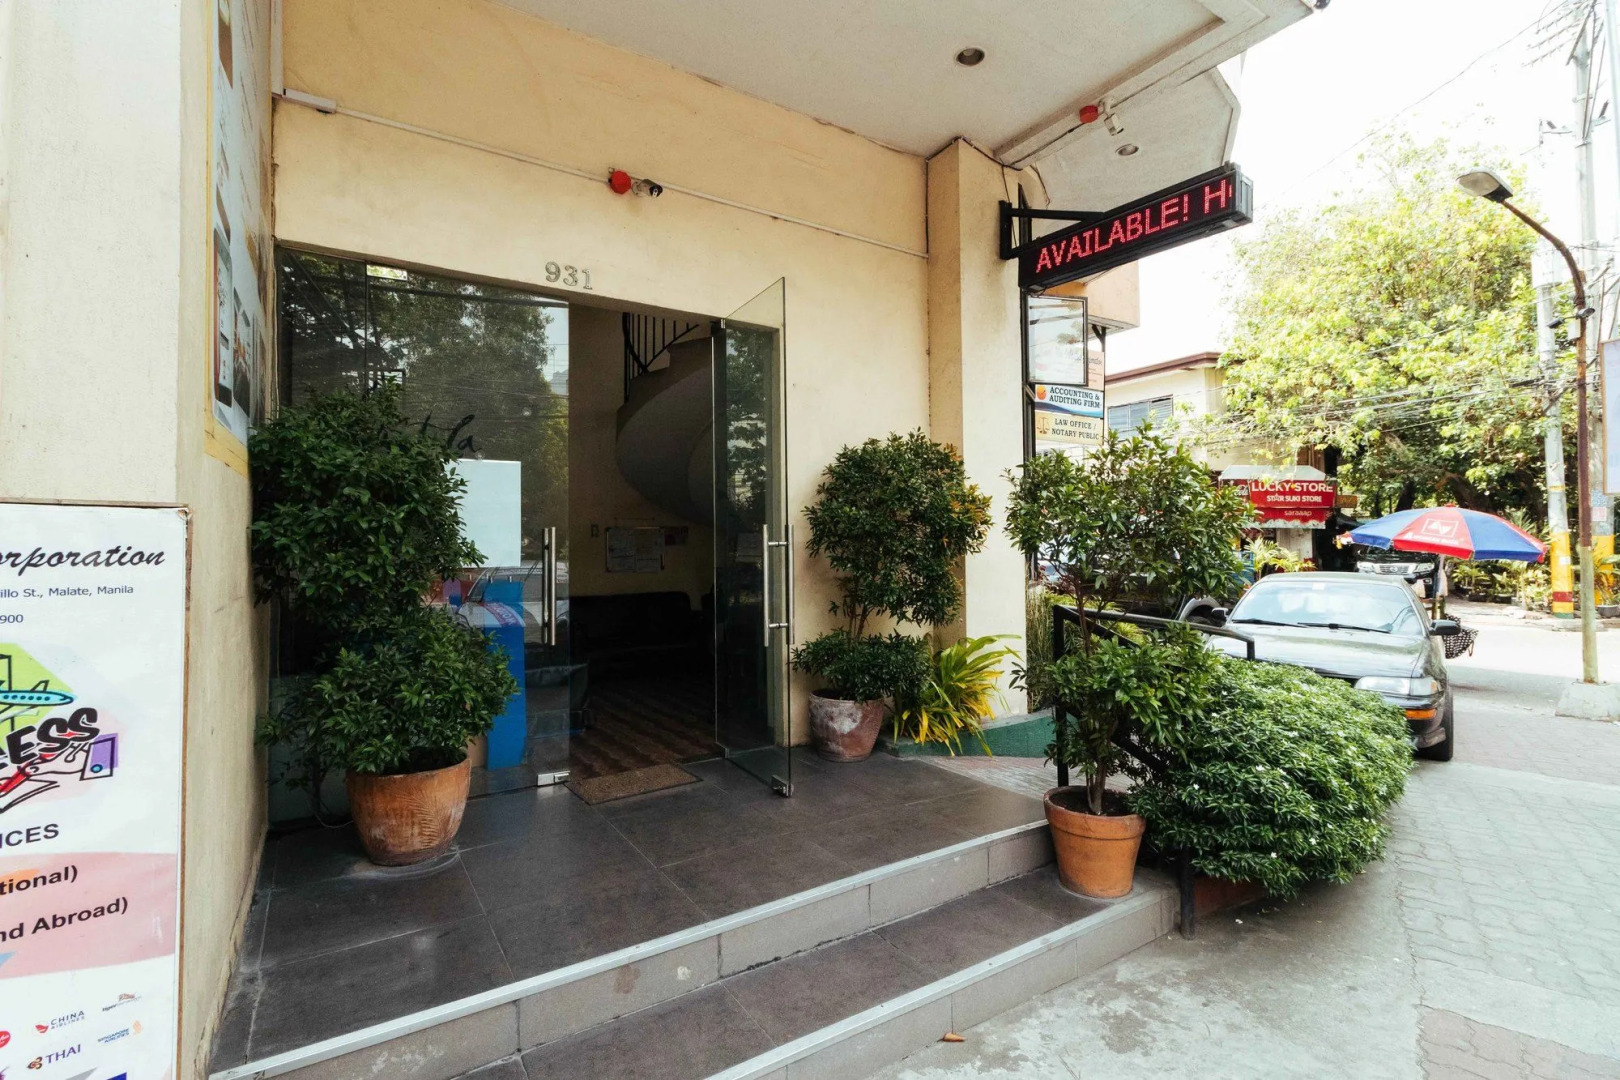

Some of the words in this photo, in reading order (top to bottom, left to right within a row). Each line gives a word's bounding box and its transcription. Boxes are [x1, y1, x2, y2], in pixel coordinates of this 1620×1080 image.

[1036, 193, 1189, 273] AVAILABLE!
[1203, 179, 1233, 214] H
[545, 261, 592, 290] 931
[1050, 387, 1093, 399] ACCOUNTING
[1049, 395, 1082, 405] AUDITING
[1083, 400, 1100, 408] FIRM
[1055, 418, 1069, 426] LAW
[1070, 420, 1092, 429] OFFICE
[1051, 428, 1077, 437] NOTARY
[1078, 431, 1100, 440] PUBLIC
[1251, 482, 1291, 492] LUCKY
[1294, 482, 1333, 492] STORE
[1301, 495, 1322, 503] STORE
[0, 545, 165, 577] rporation
[23, 588, 44, 599] St.,
[49, 586, 92, 597] Malate,
[97, 585, 134, 595] Manila
[31, 896, 128, 934] Abroad)
[50, 1010, 85, 1026] CHINA
[45, 1044, 81, 1064] THAI
